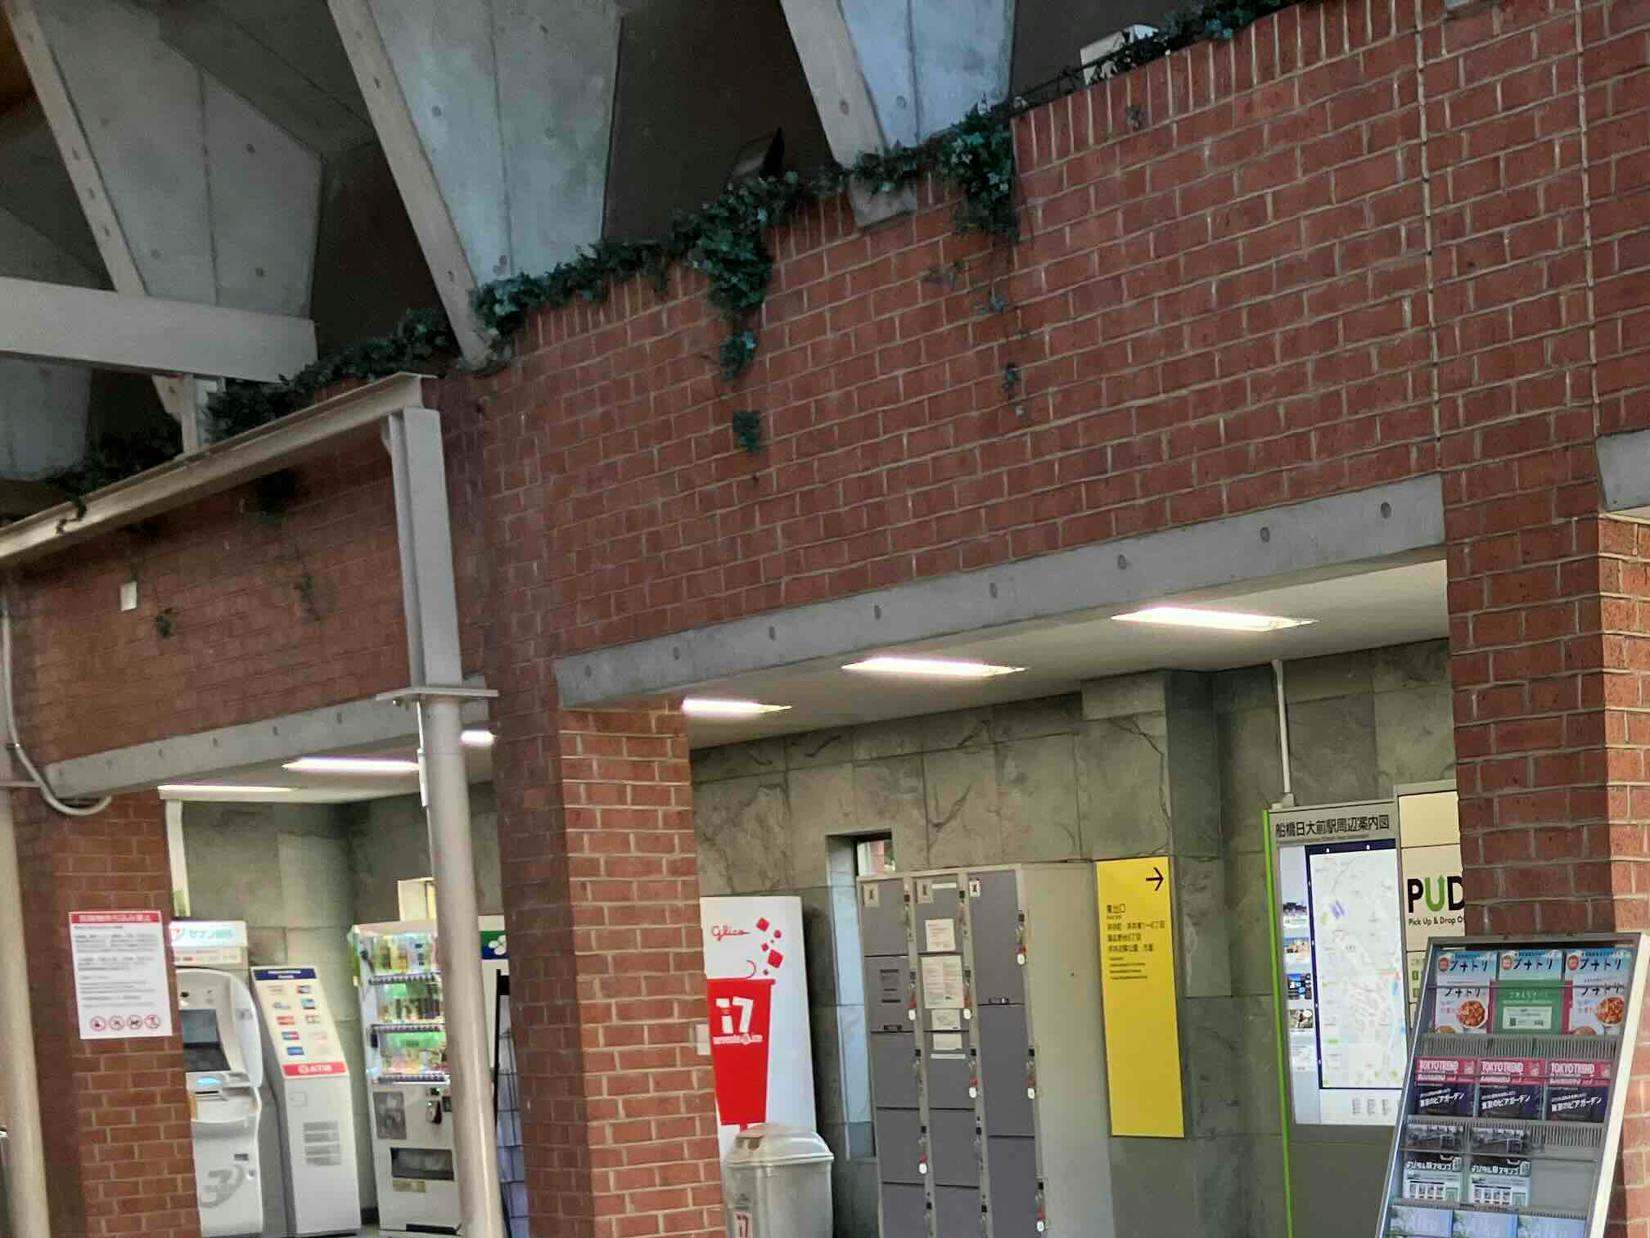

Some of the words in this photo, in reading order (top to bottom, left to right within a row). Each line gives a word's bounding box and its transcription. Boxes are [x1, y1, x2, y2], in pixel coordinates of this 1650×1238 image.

[1276, 815, 1389, 837] 船橋日大前駅周辺案内図
[1408, 918, 1421, 927] Pick
[1423, 917, 1432, 927] Up
[1440, 916, 1456, 925] Drop
[711, 924, 750, 941] Glico
